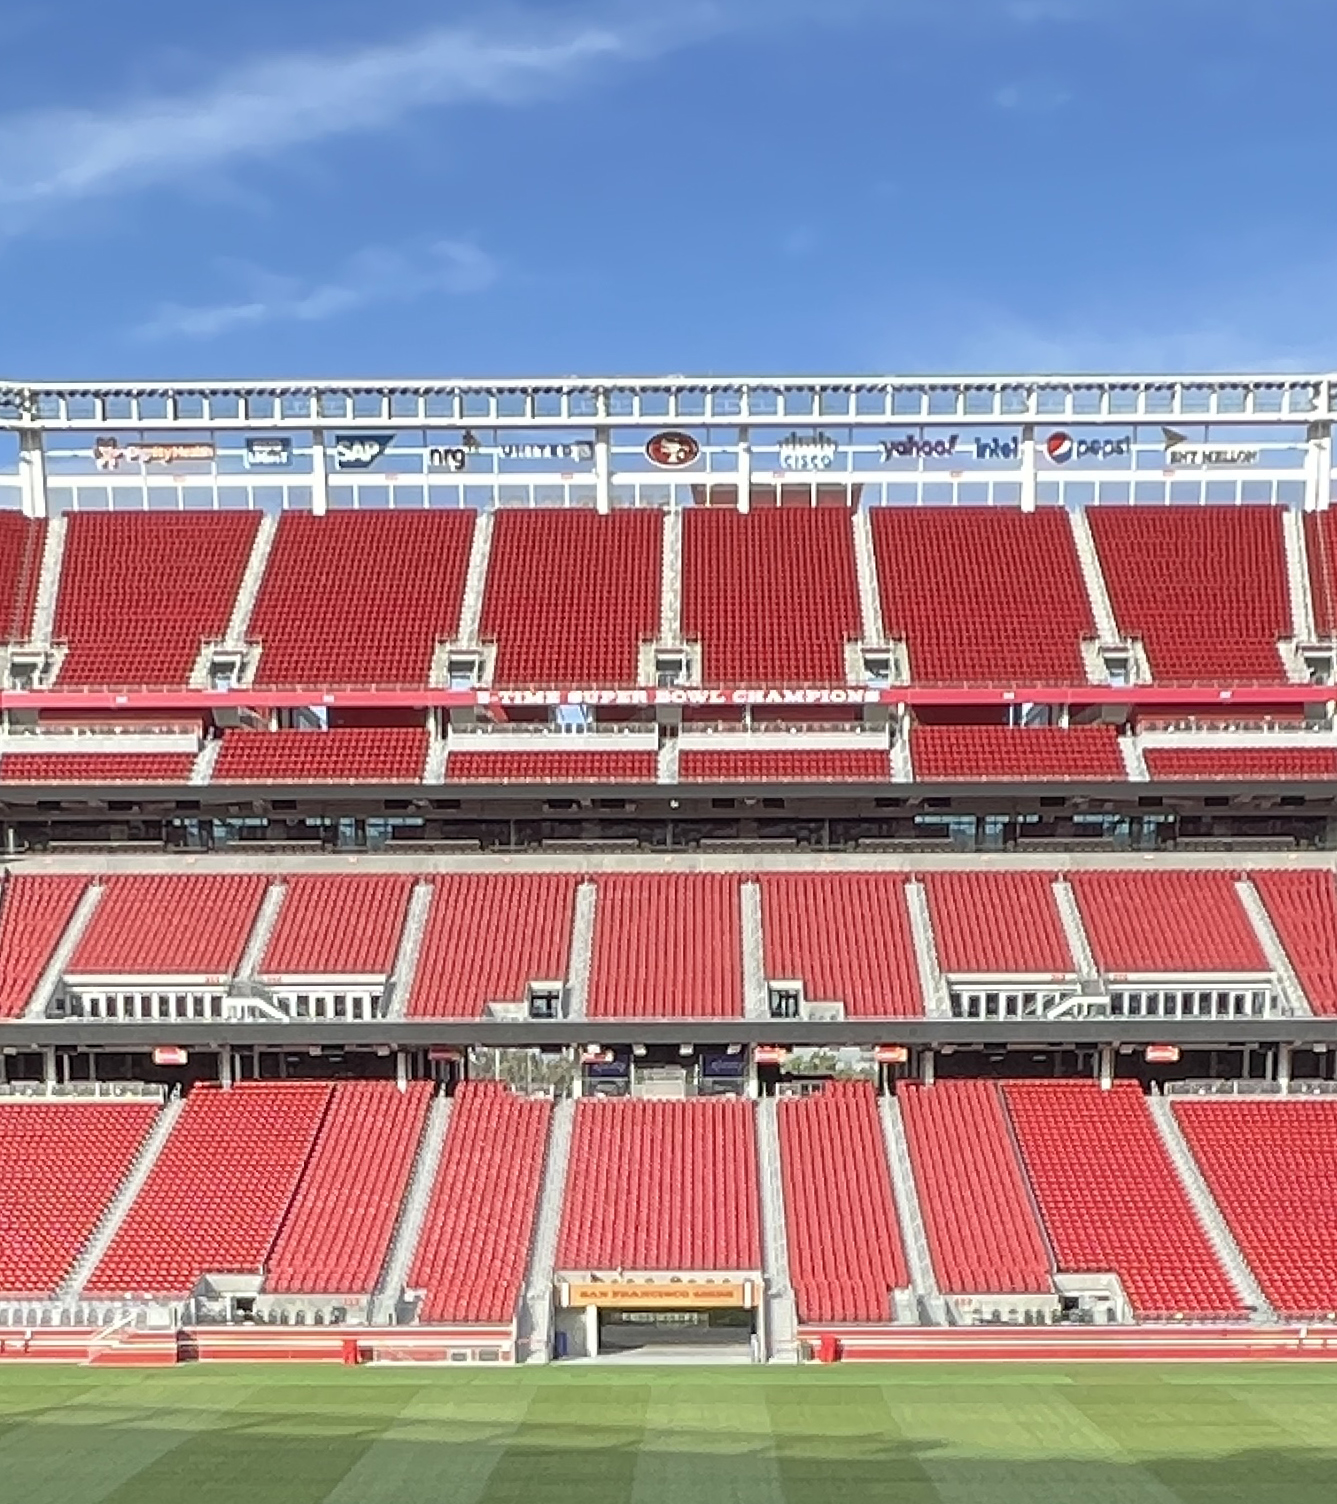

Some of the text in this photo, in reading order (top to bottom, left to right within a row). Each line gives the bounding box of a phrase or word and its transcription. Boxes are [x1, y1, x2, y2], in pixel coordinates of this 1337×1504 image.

[337, 440, 379, 461] SAP
[430, 446, 465, 469] nrg
[880, 434, 959, 461] yahoo!
[1076, 436, 1131, 460] pepsi
[568, 690, 648, 703] SUPER
[655, 690, 726, 703] BOWL
[730, 690, 880, 703] CHAMPIONS
